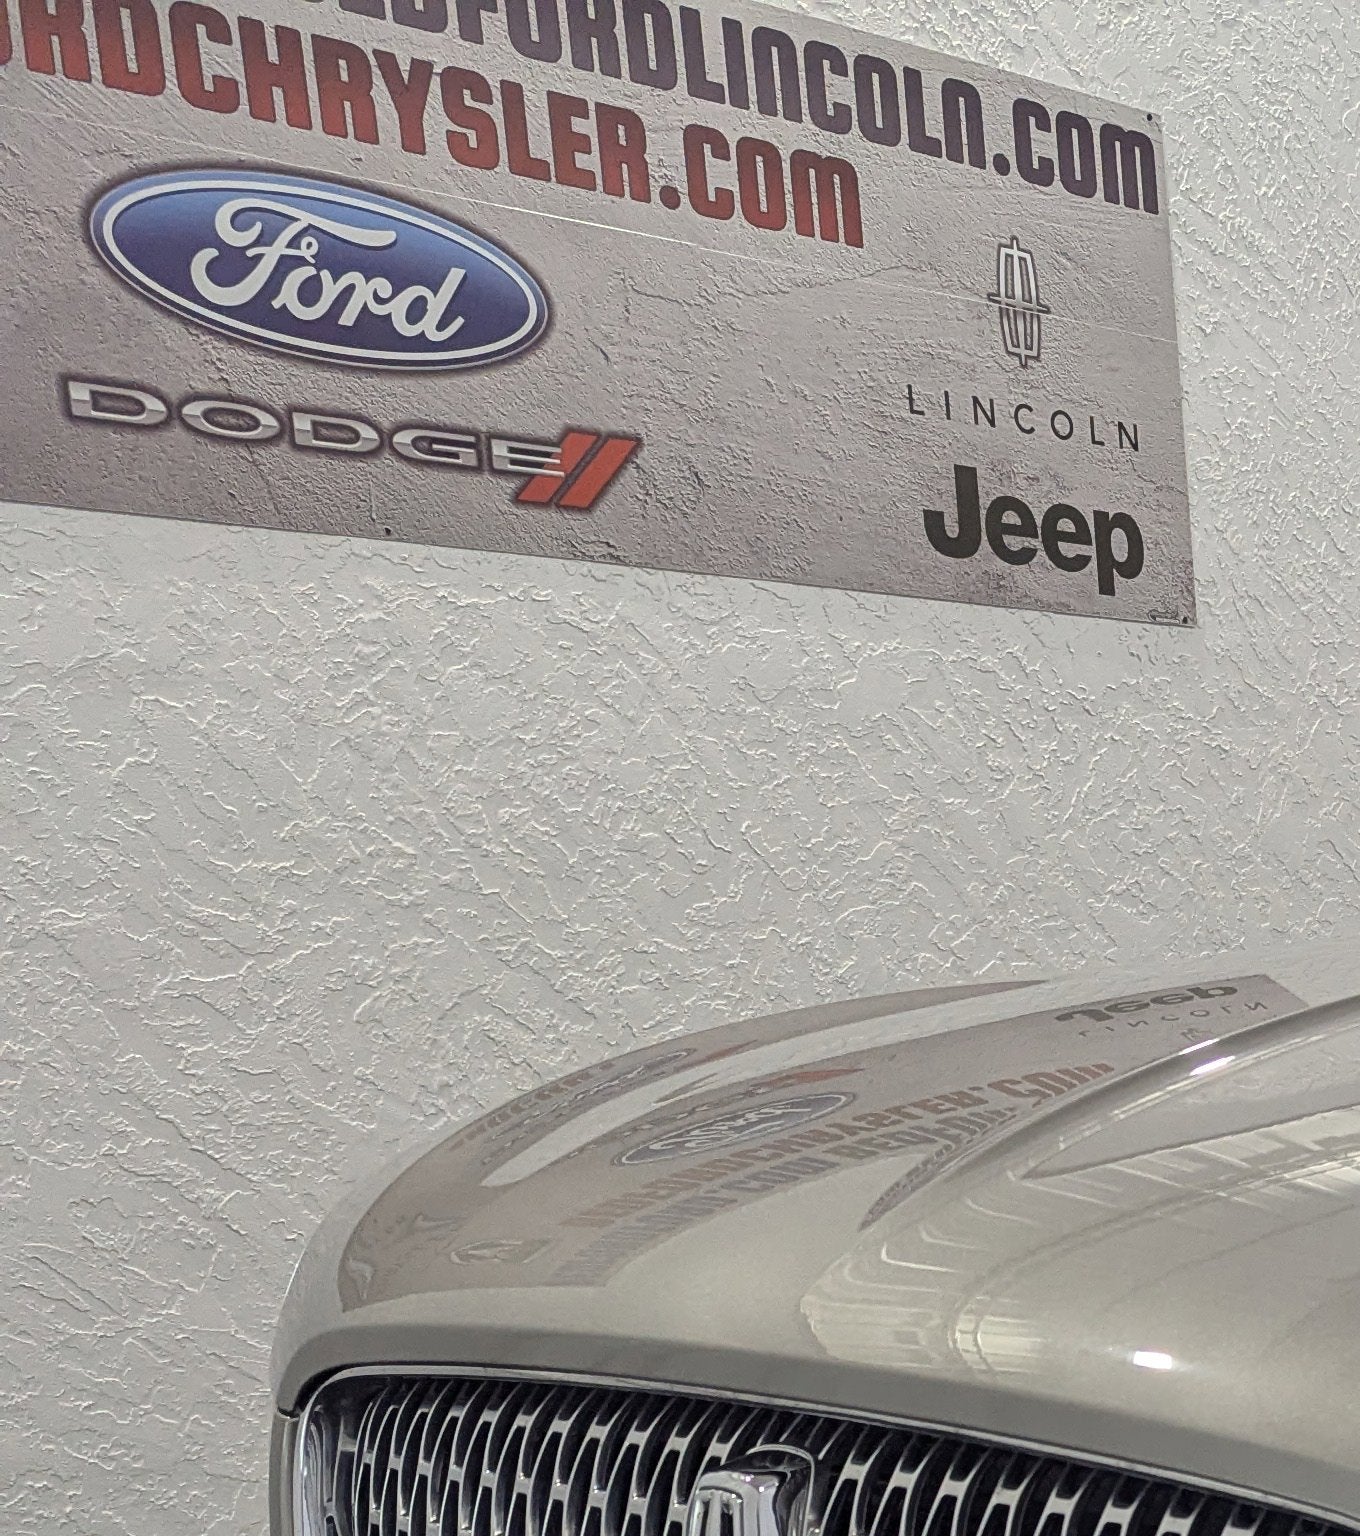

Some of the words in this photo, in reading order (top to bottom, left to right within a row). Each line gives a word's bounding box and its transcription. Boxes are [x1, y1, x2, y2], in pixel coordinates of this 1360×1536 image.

[0, 0, 864, 248] RDCHRYSLER.COM
[190, 198, 464, 343] Ford
[66, 380, 565, 478] DODGE
[907, 383, 1140, 452] LINCOLN
[923, 464, 1144, 597] Jeep
